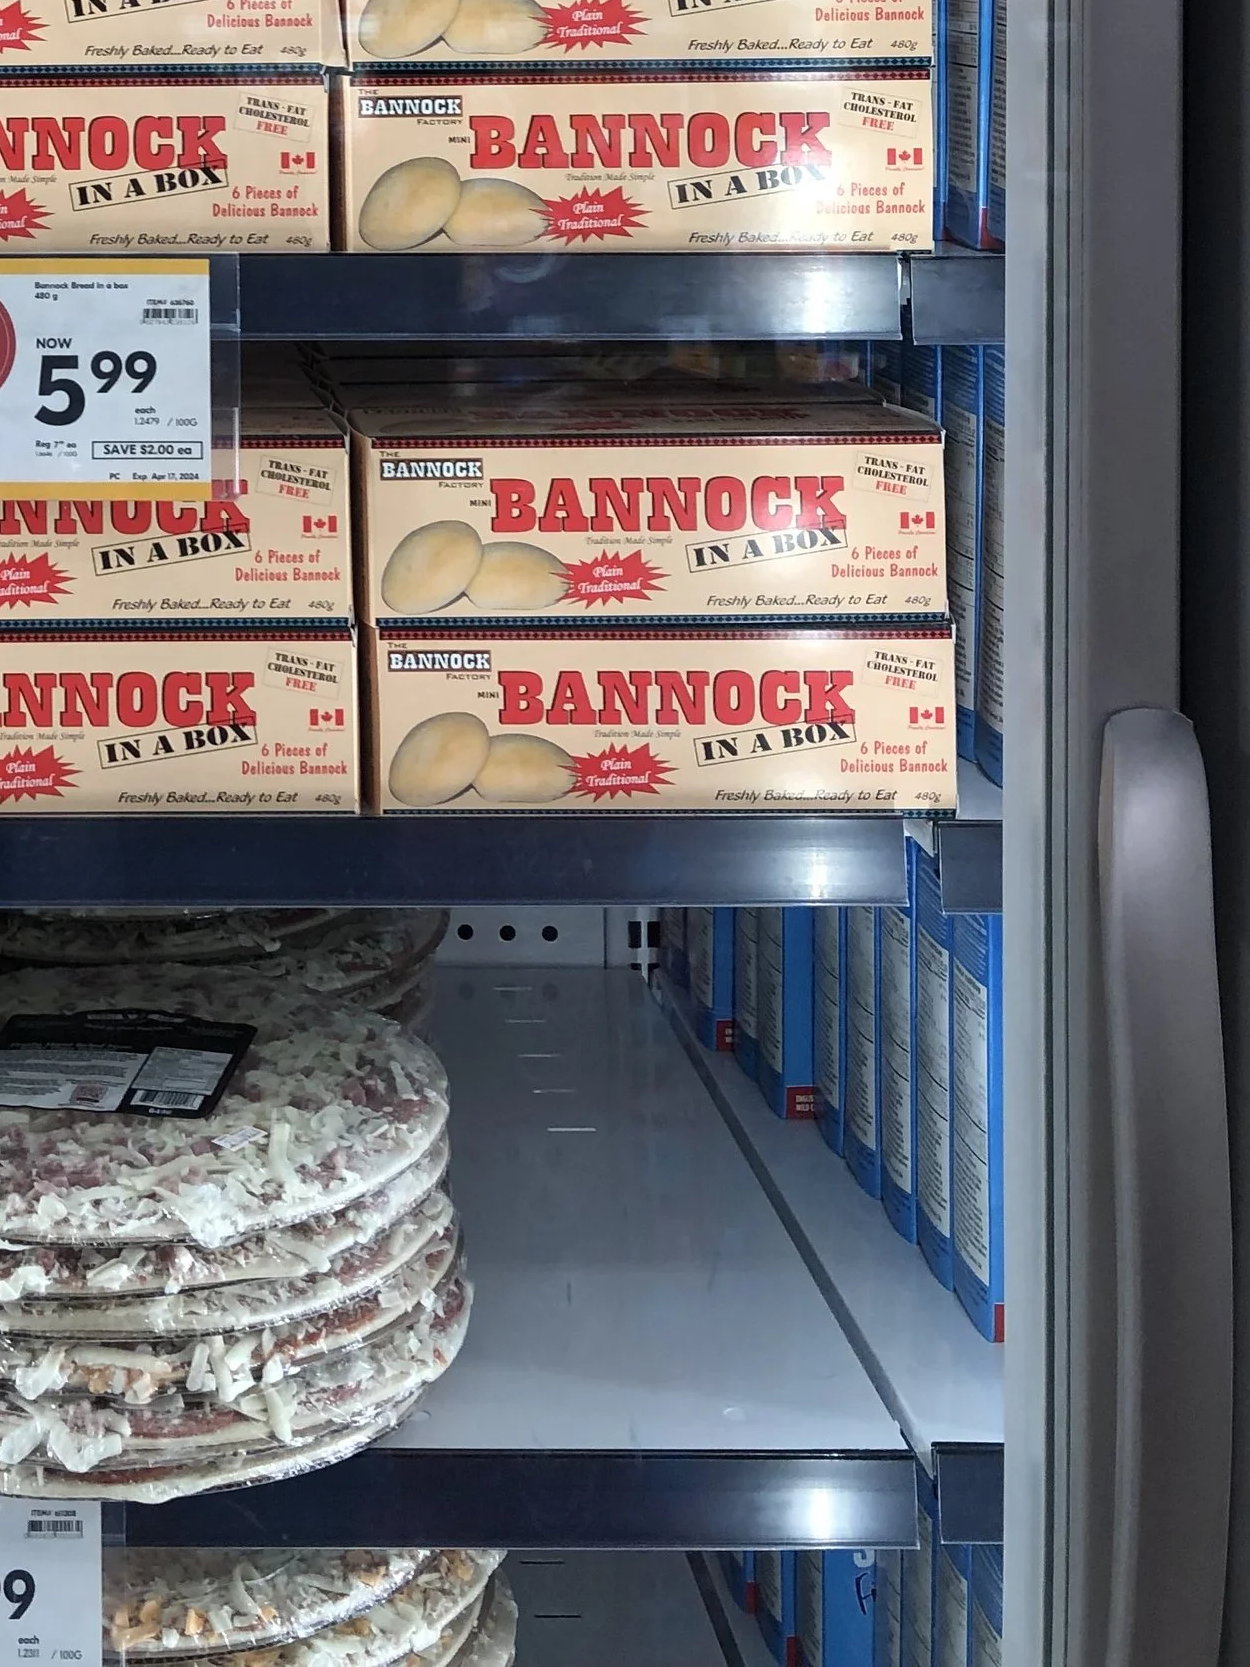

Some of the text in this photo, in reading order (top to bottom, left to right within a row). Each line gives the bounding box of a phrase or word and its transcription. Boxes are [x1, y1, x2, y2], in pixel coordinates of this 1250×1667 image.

[469, 111, 833, 169] BANNOCK
[231, 184, 298, 199] 6 Pieces of
[211, 203, 317, 217] Delicious Bannock
[34, 281, 69, 290] Bannock
[71, 281, 94, 290] Bread
[35, 337, 73, 350] NOW
[134, 406, 156, 414] each
[103, 443, 192, 456] SAVE $2.00 ea
[109, 472, 120, 480] PC
[151, 472, 165, 482] Apr
[490, 475, 848, 532] BANNOCK
[498, 670, 856, 725] BANNOCK
[701, 720, 851, 761] IN A BOX
[17, 1635, 40, 1645] each
